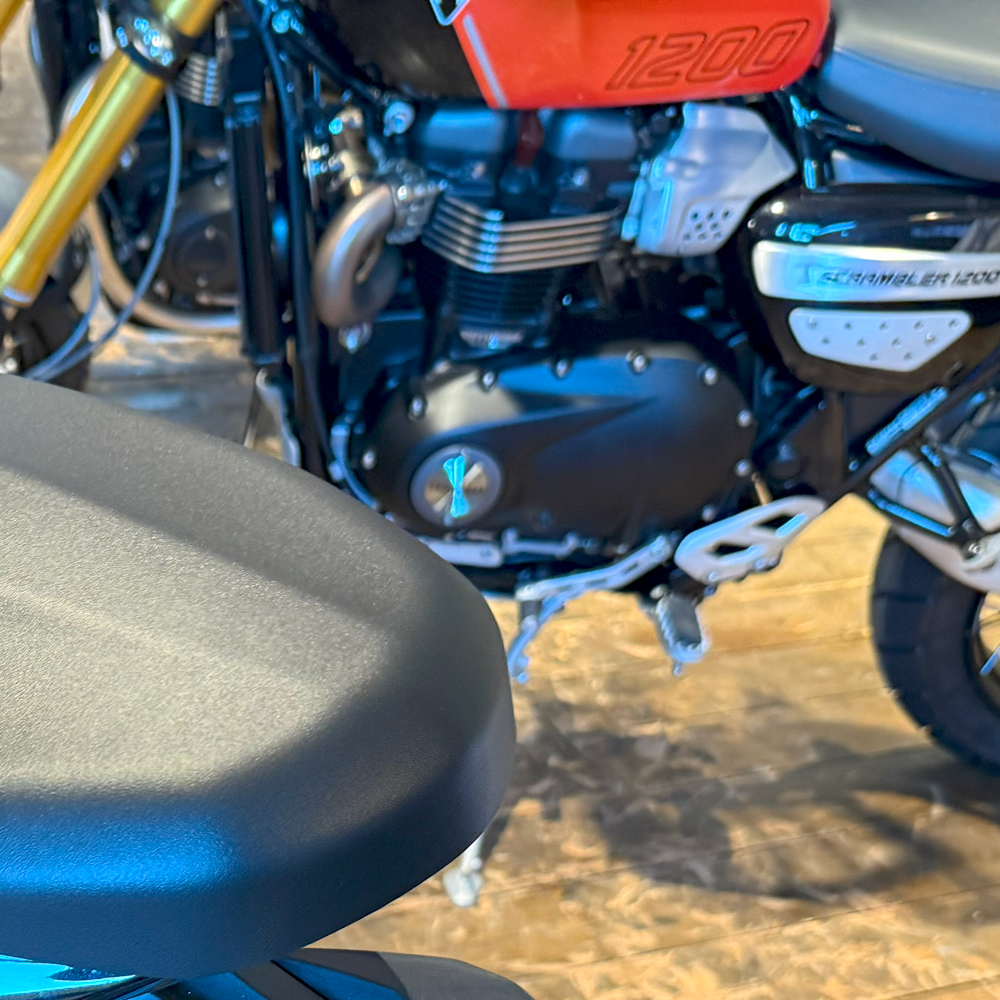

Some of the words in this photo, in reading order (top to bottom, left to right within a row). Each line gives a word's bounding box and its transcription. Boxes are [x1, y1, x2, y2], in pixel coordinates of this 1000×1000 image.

[605, 18, 810, 90] 1200
[822, 270, 950, 287] SCRAMBLER
[951, 269, 1000, 286] 1200
